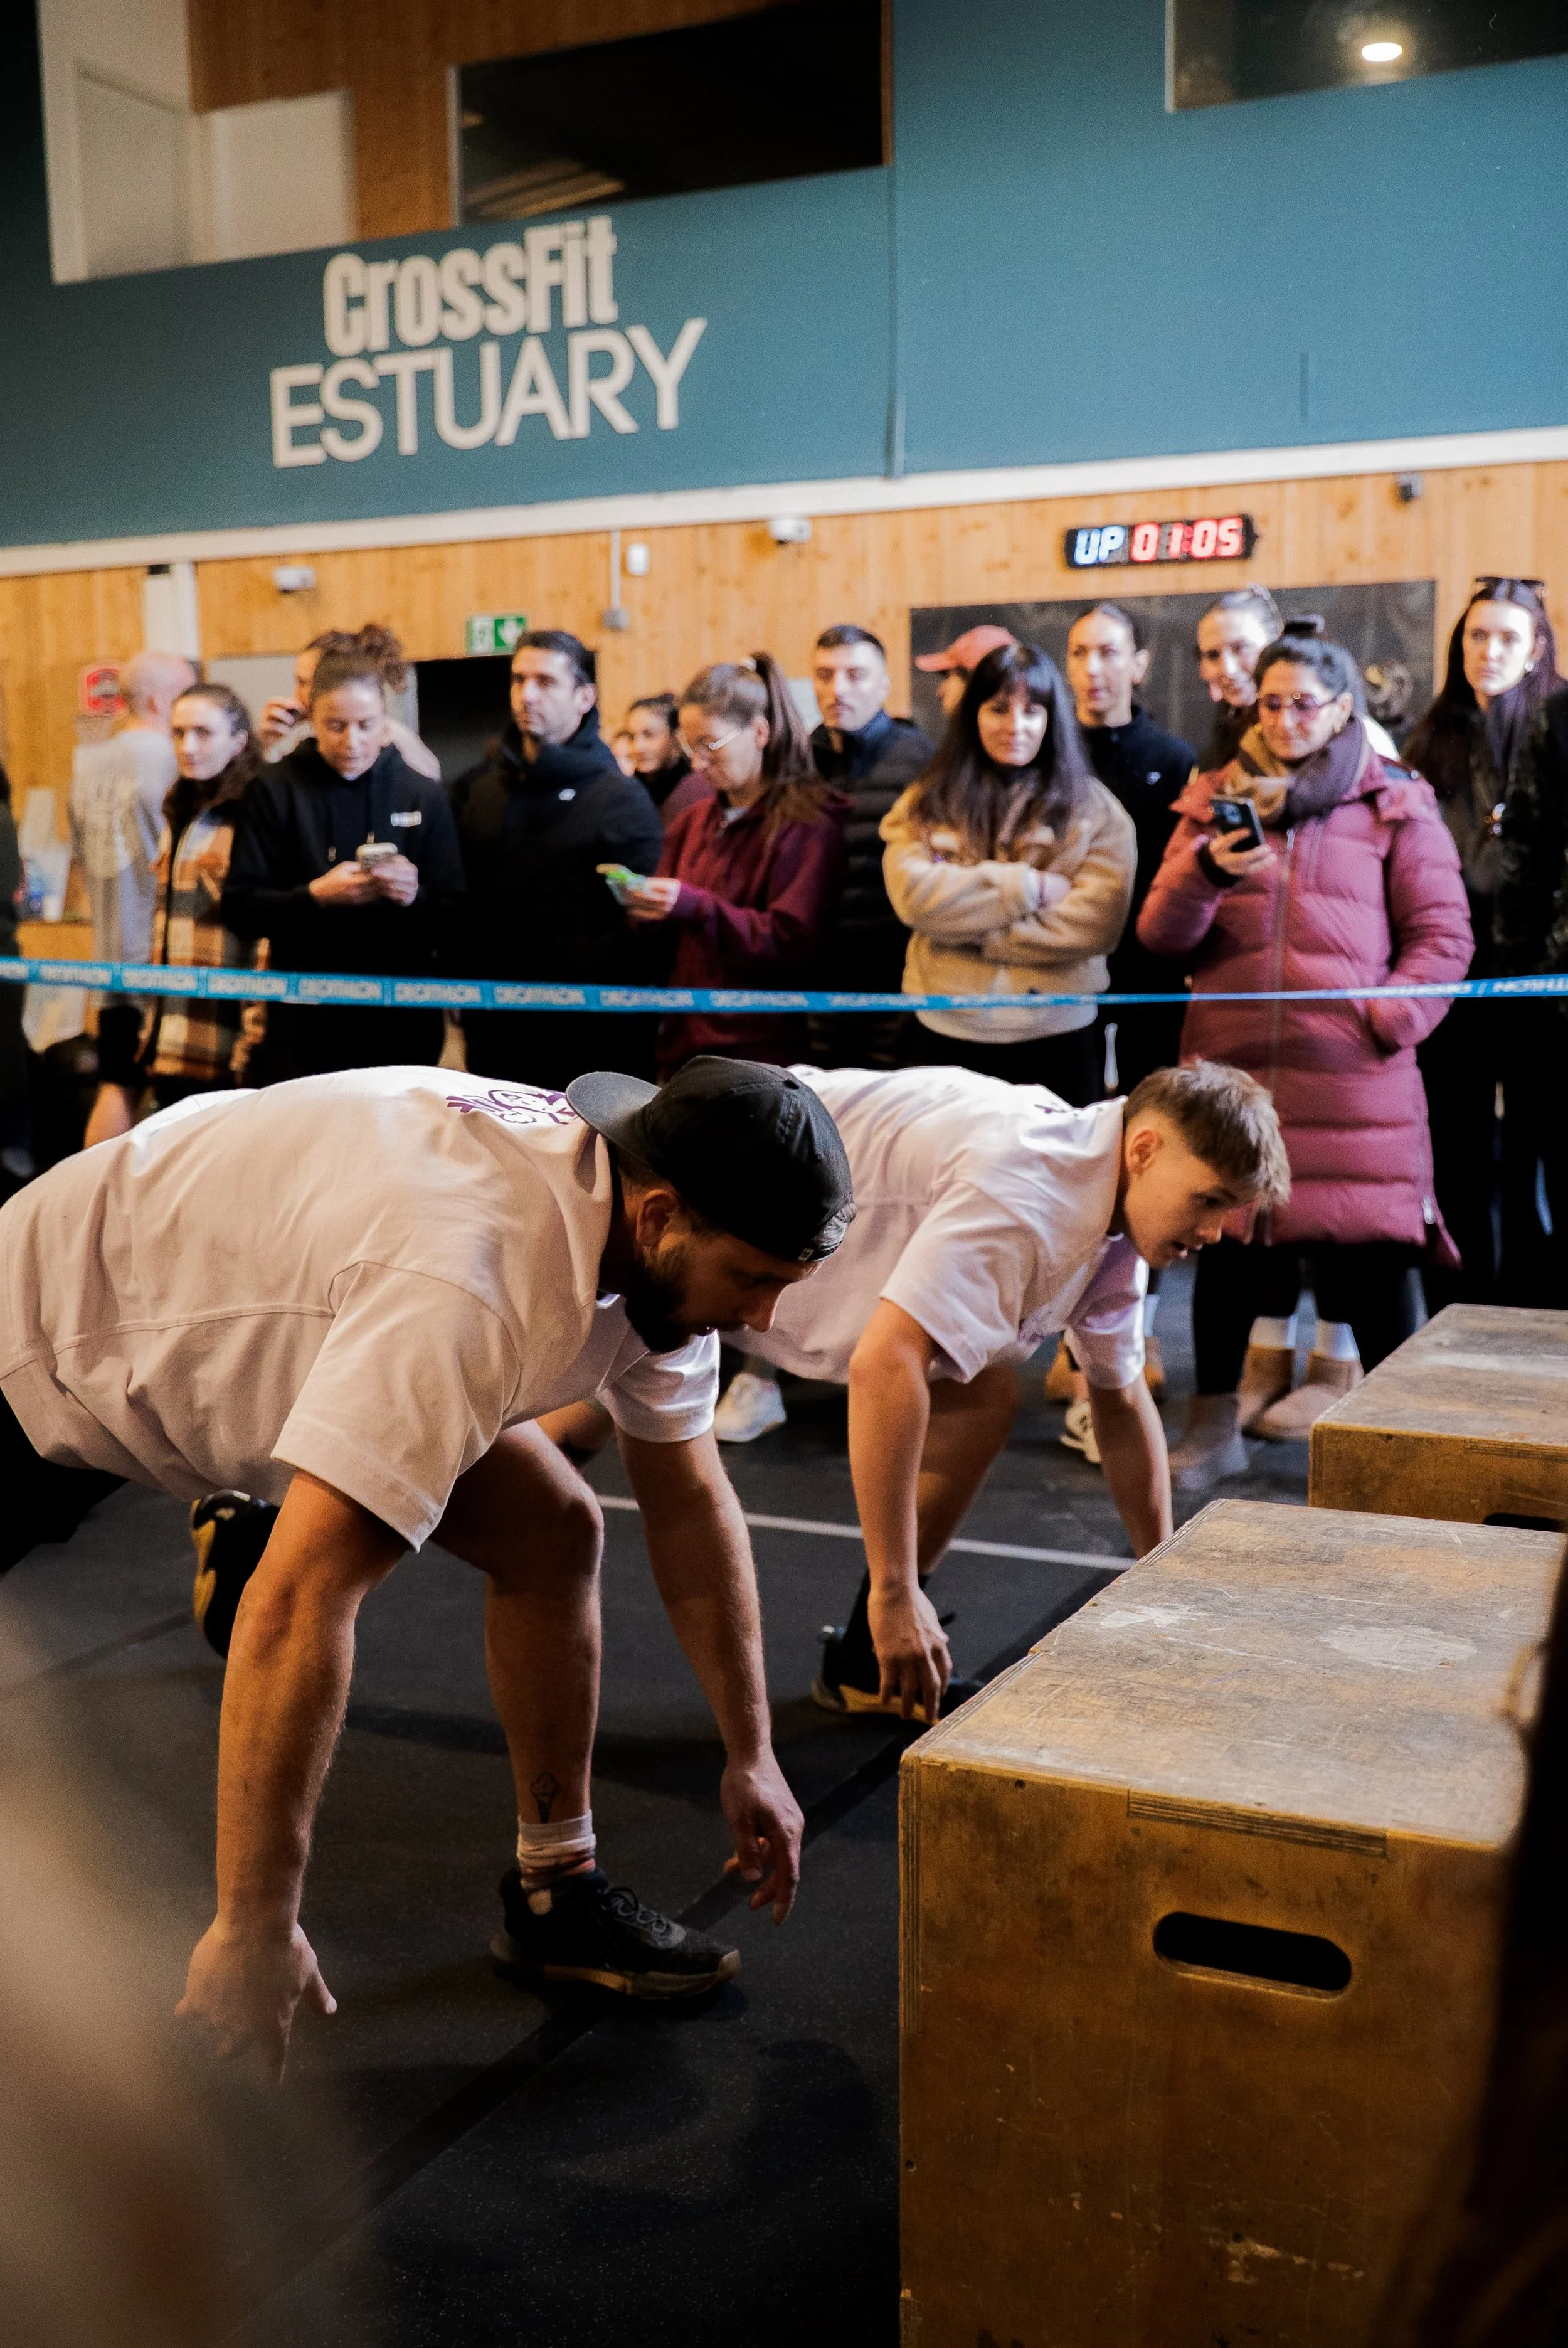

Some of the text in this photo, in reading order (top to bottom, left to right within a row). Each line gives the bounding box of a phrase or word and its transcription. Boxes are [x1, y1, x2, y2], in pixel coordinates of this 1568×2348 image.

[324, 215, 618, 357] CrossFit
[270, 317, 707, 469] ESTUARY
[1074, 516, 1244, 565] UP 01:05
